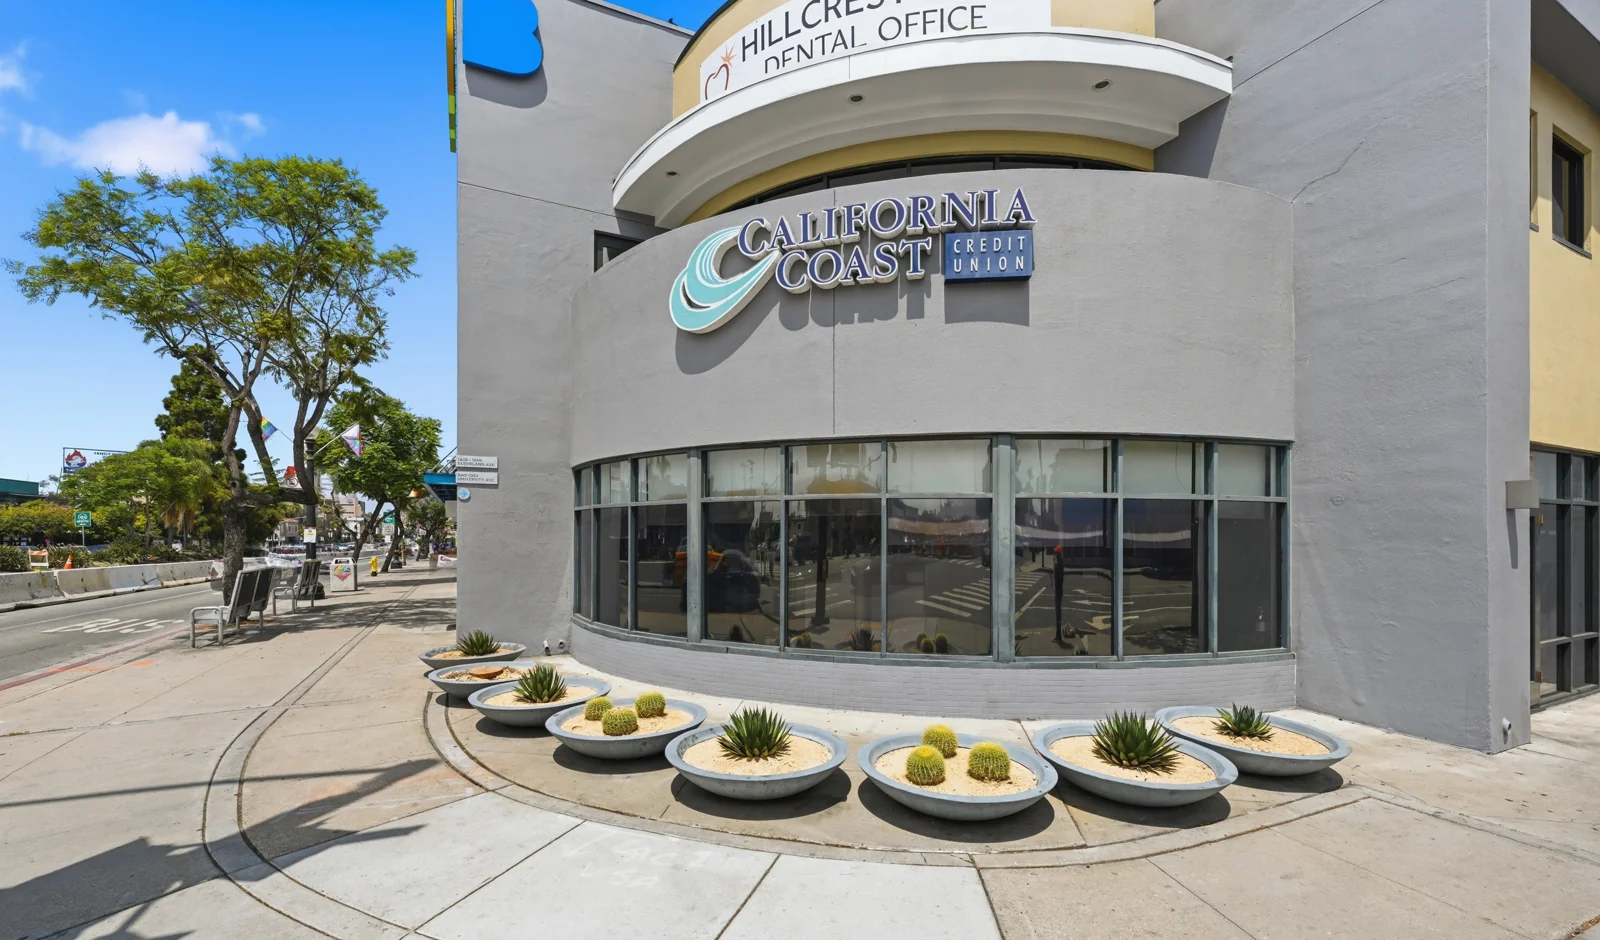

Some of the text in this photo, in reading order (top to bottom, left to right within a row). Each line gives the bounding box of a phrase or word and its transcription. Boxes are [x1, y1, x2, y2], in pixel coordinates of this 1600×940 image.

[741, 0, 901, 62] HILLCRE
[764, 5, 988, 74] DENTAL OFFICE
[737, 188, 1036, 259] CALIFORNIA
[953, 235, 1026, 254] CREDIT
[775, 237, 931, 291] COAST
[953, 255, 1025, 274] UNION
[41, 618, 185, 633] BUS
